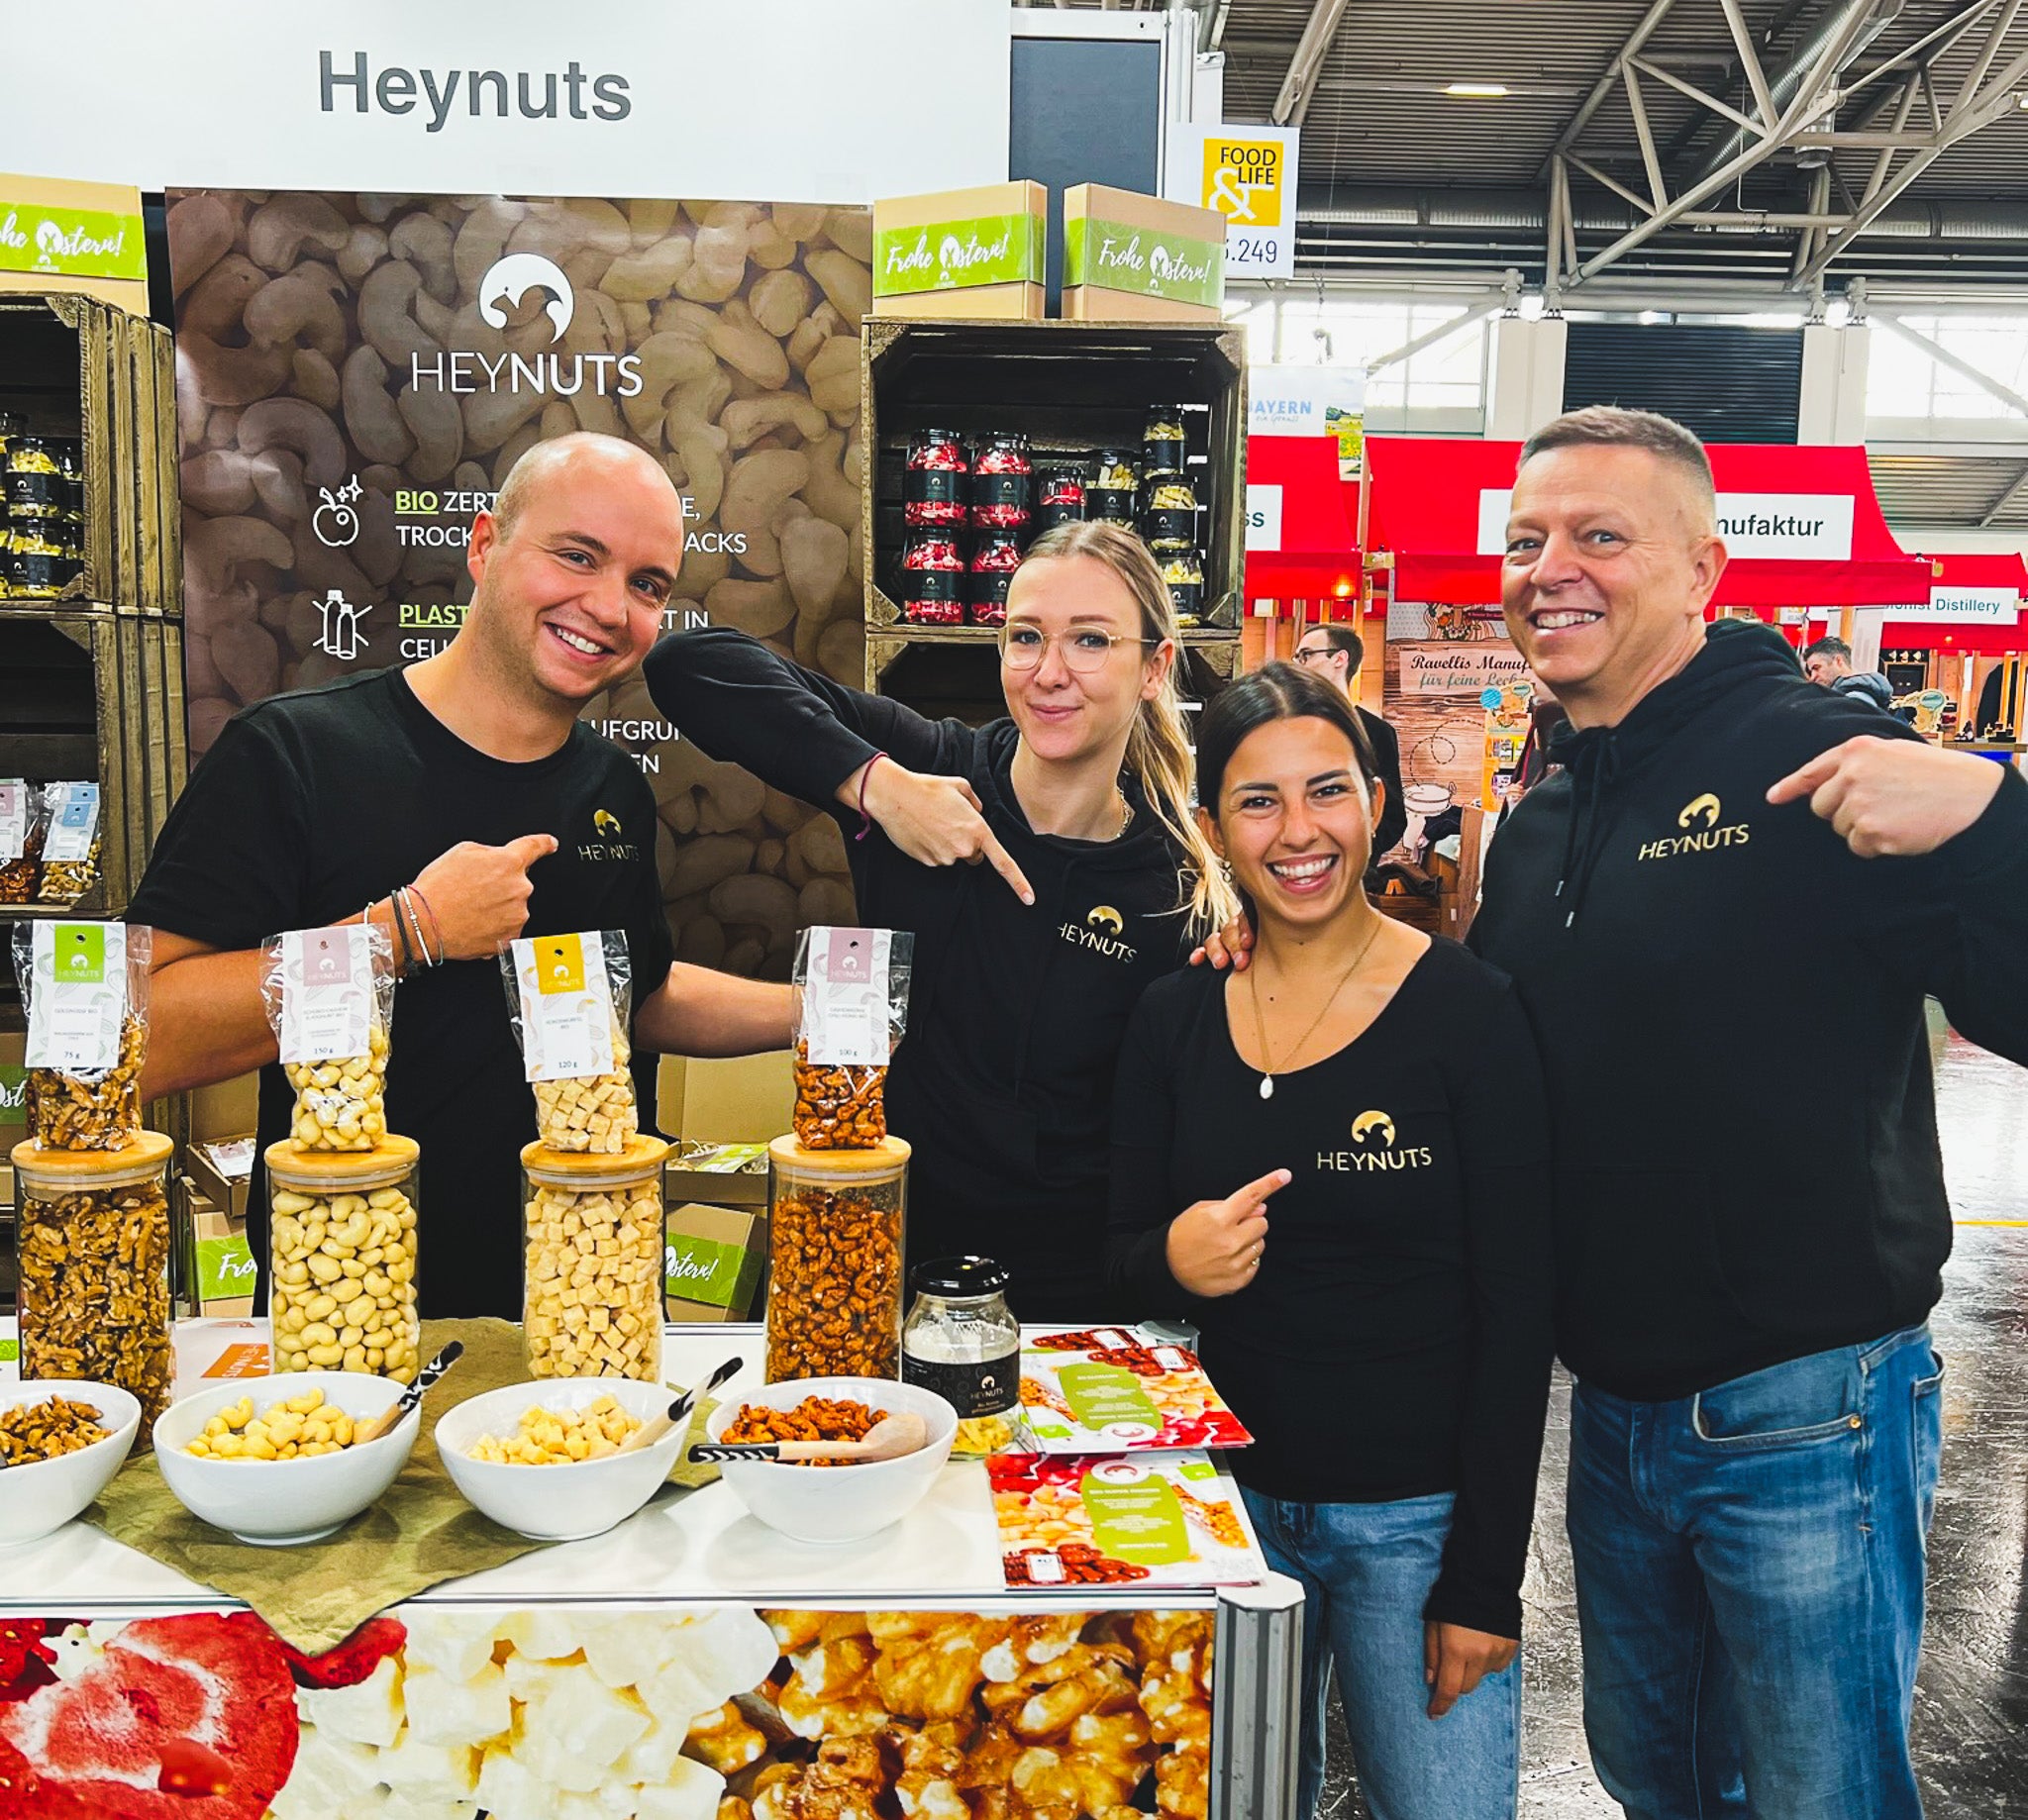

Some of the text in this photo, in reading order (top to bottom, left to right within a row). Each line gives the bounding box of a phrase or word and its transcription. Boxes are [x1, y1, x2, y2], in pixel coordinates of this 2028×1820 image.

[320, 51, 632, 133] Heynuts
[1220, 147, 1276, 166] FOOD
[1238, 167, 1275, 185] LIFE
[886, 235, 934, 274] Frohe
[1098, 236, 1145, 272] Frohe
[411, 352, 644, 397] HEYNUTS
[395, 491, 439, 514] BIO
[684, 532, 747, 554] ACKS
[1936, 598, 2001, 615] Distillery
[684, 610, 709, 630] IN
[1411, 655, 1534, 674] Ravellis Manuf
[1419, 672, 1443, 690] für
[1447, 672, 1480, 690] feine
[1638, 824, 1750, 861] HEYNUTS
[1317, 1147, 1432, 1171] HEYNUTS
